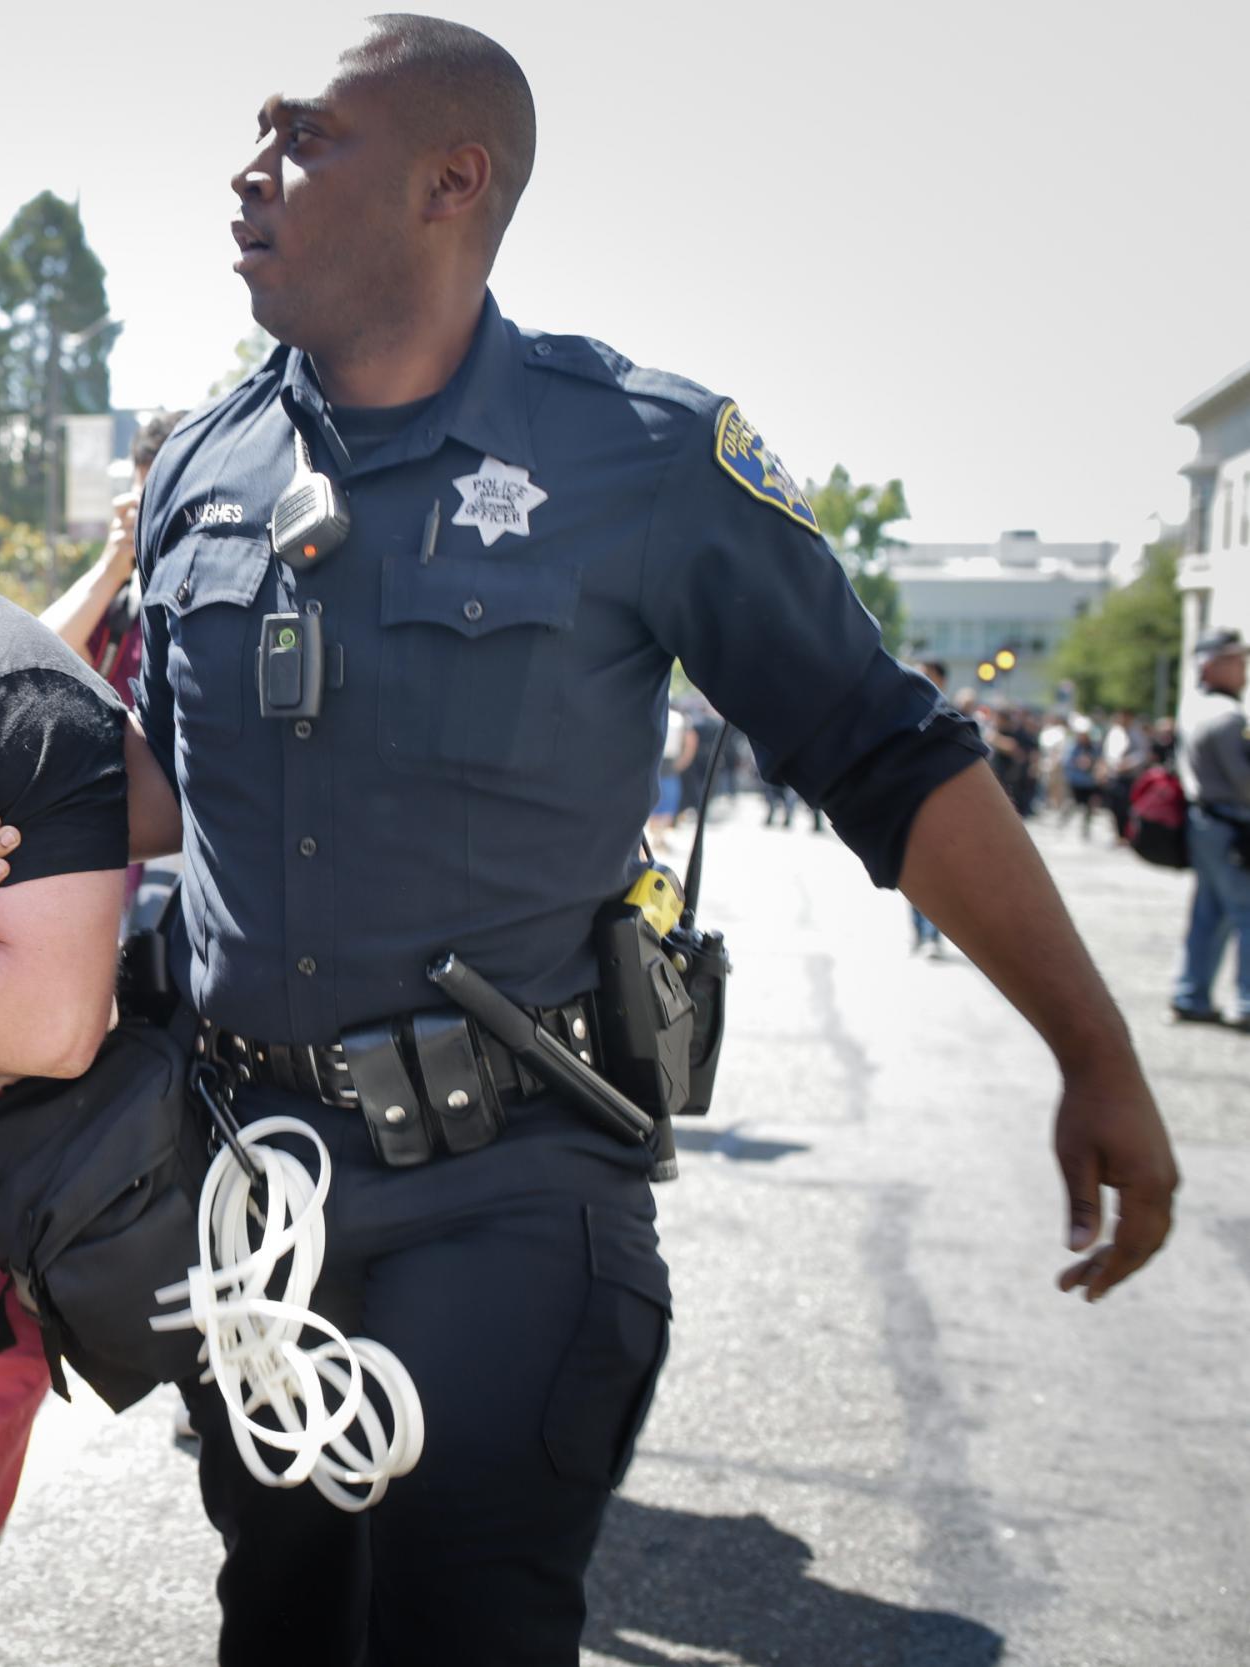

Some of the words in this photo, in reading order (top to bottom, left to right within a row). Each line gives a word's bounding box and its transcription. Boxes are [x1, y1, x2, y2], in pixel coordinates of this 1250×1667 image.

[472, 479, 529, 501] POLICE
[194, 503, 243, 524] HUGHES
[464, 503, 521, 524] OFFICER
